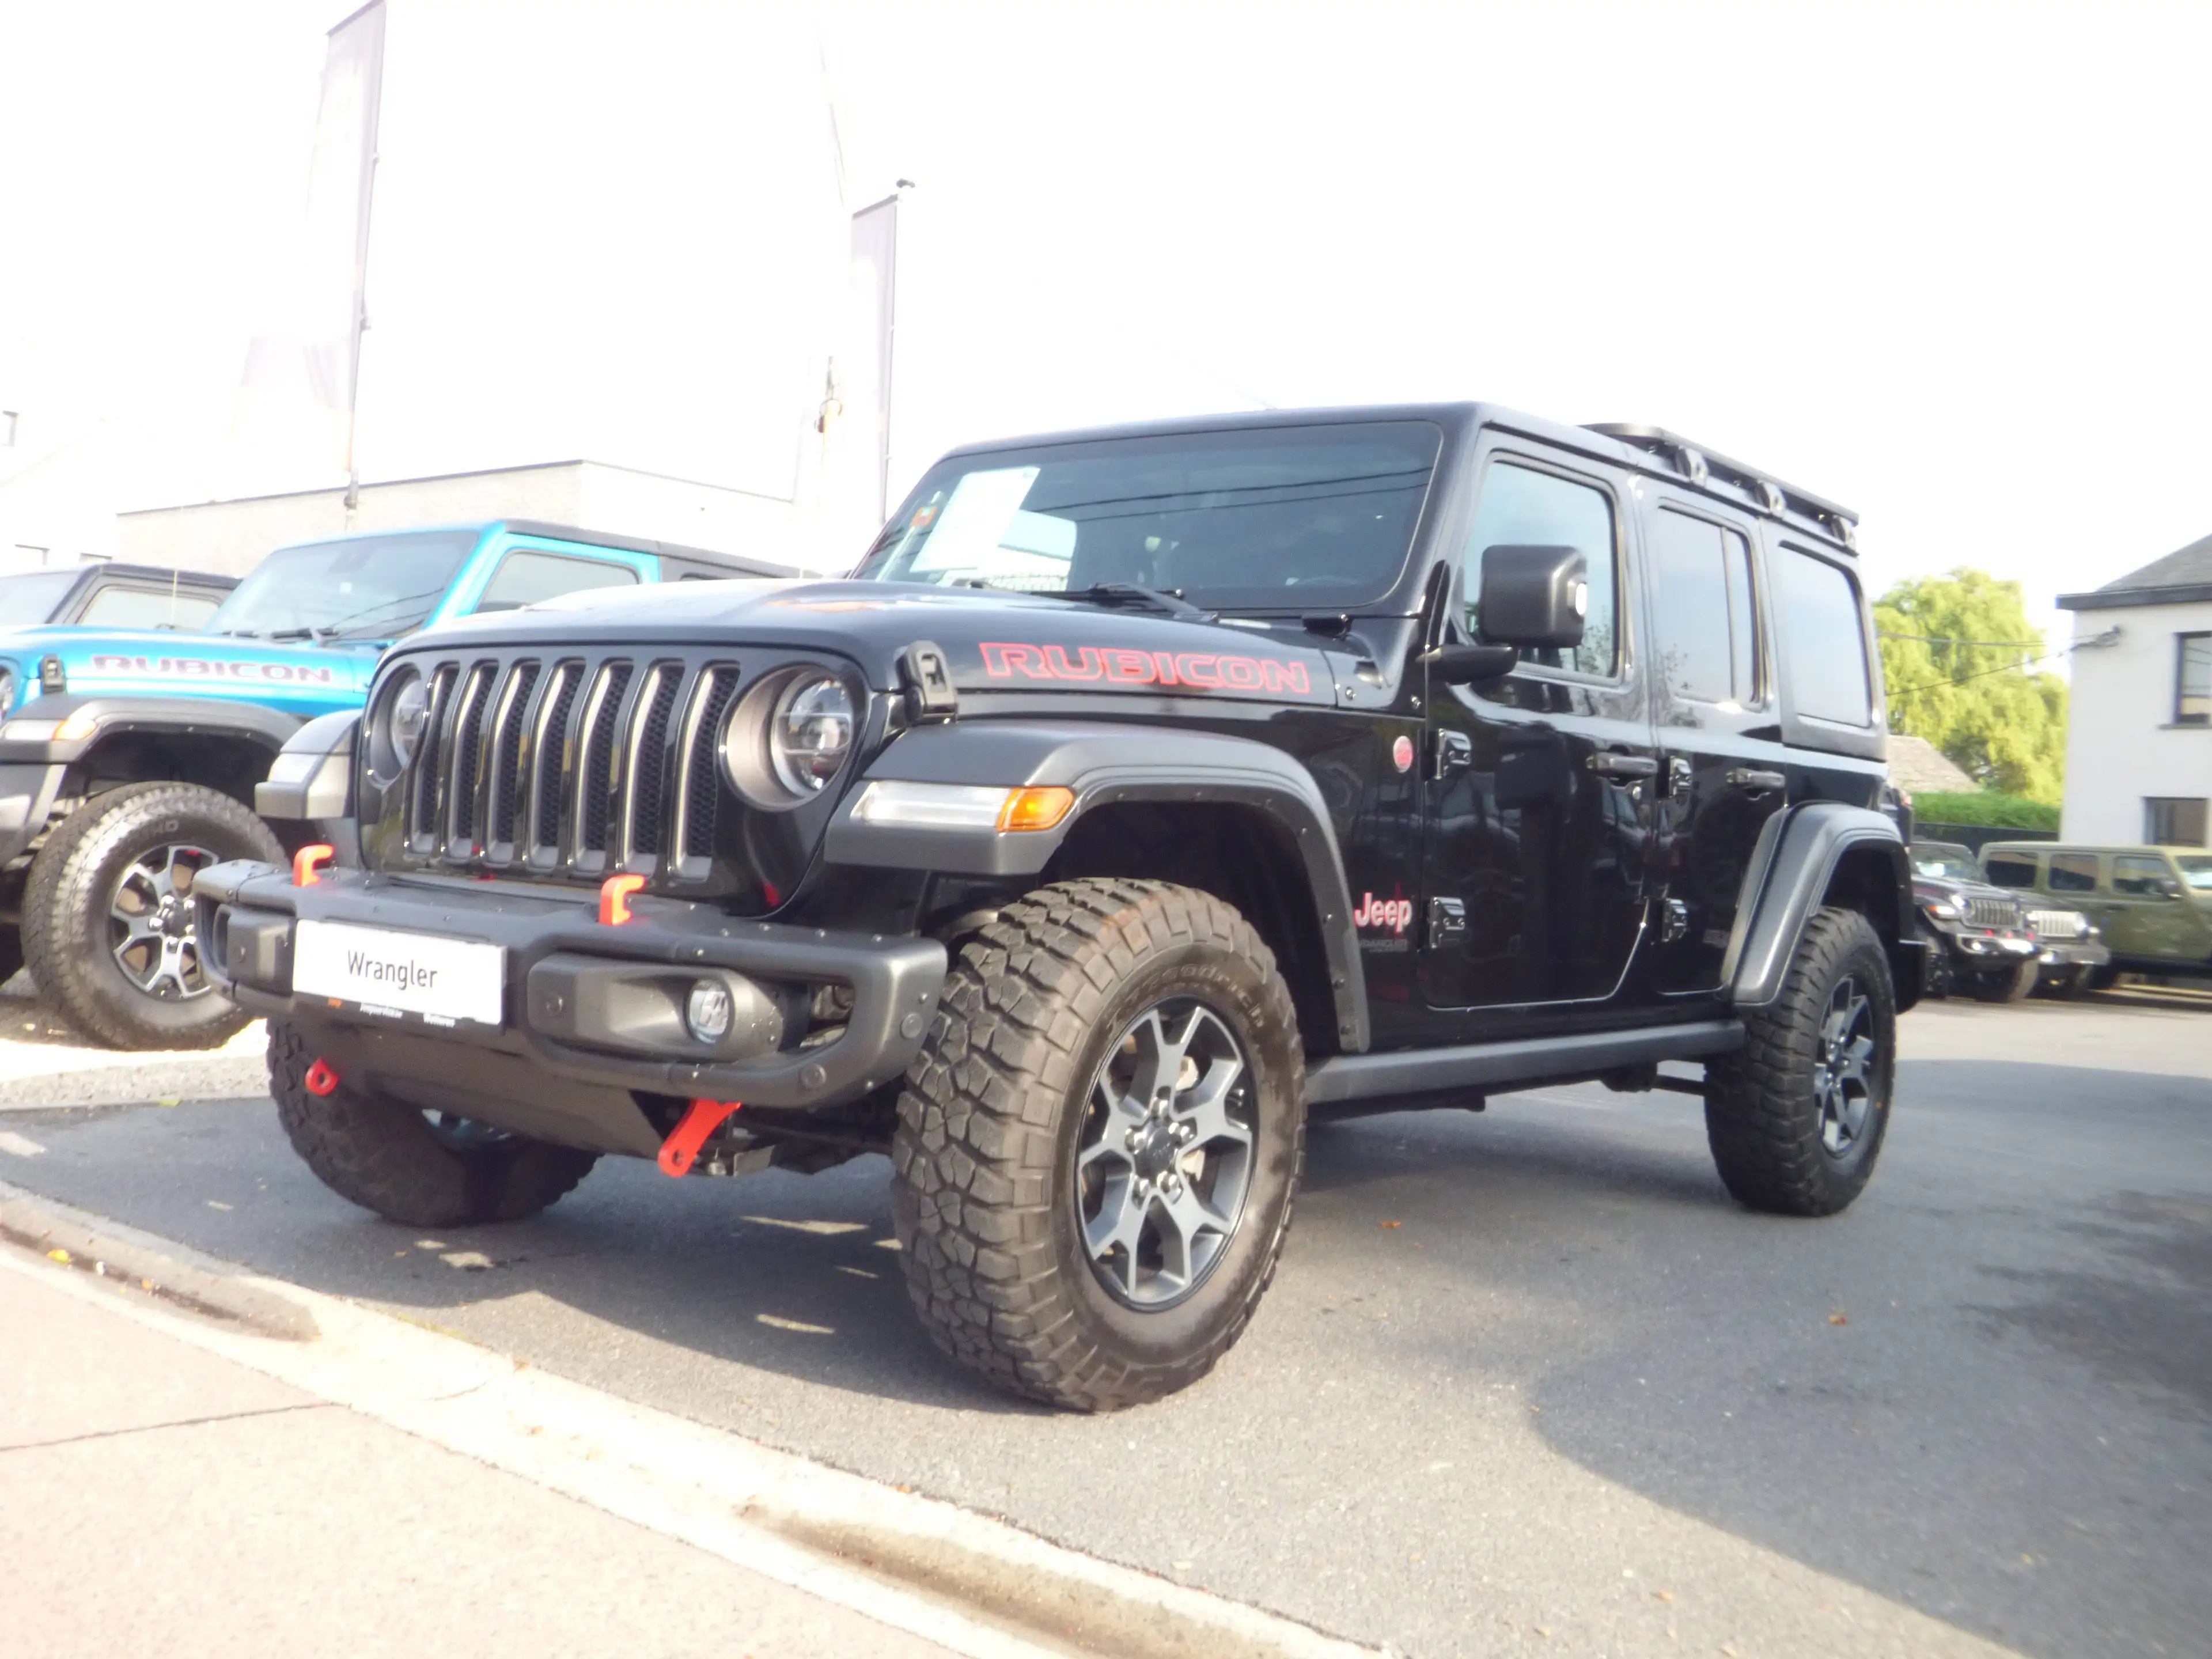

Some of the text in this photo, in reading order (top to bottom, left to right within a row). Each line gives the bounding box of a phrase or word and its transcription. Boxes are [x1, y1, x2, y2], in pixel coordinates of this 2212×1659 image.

[92, 655, 331, 683] RUBICON
[980, 642, 1310, 694] RUBICON
[1354, 891, 1411, 934] Jeep
[347, 949, 438, 990] Wrangler
